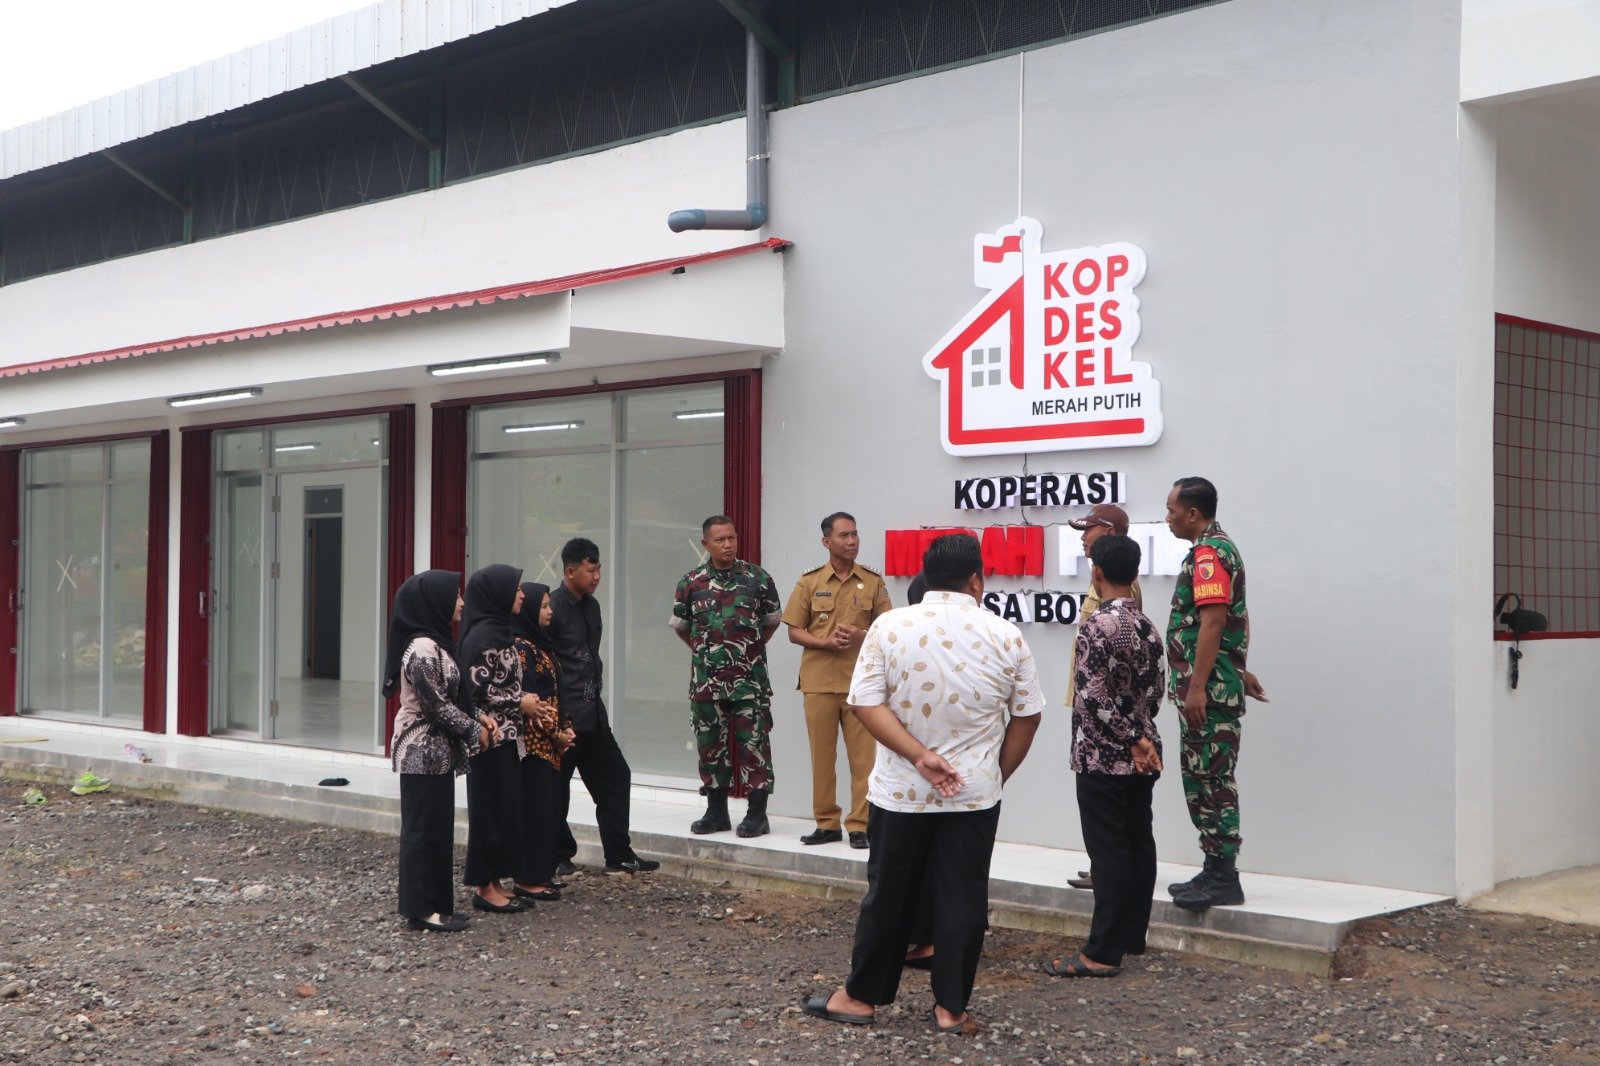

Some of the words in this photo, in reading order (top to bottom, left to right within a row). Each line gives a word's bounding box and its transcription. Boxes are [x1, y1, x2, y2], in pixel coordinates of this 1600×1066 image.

[1043, 254, 1129, 300] KOP
[1043, 299, 1122, 346] DES
[1043, 347, 1133, 390] KEL
[1032, 396, 1088, 415] MERAH
[1093, 392, 1141, 411] PUTIH
[954, 471, 1119, 509] KOPERASI
[885, 525, 1044, 576] MAH
[983, 593, 1025, 623] SA
[1034, 592, 1089, 625] BO
